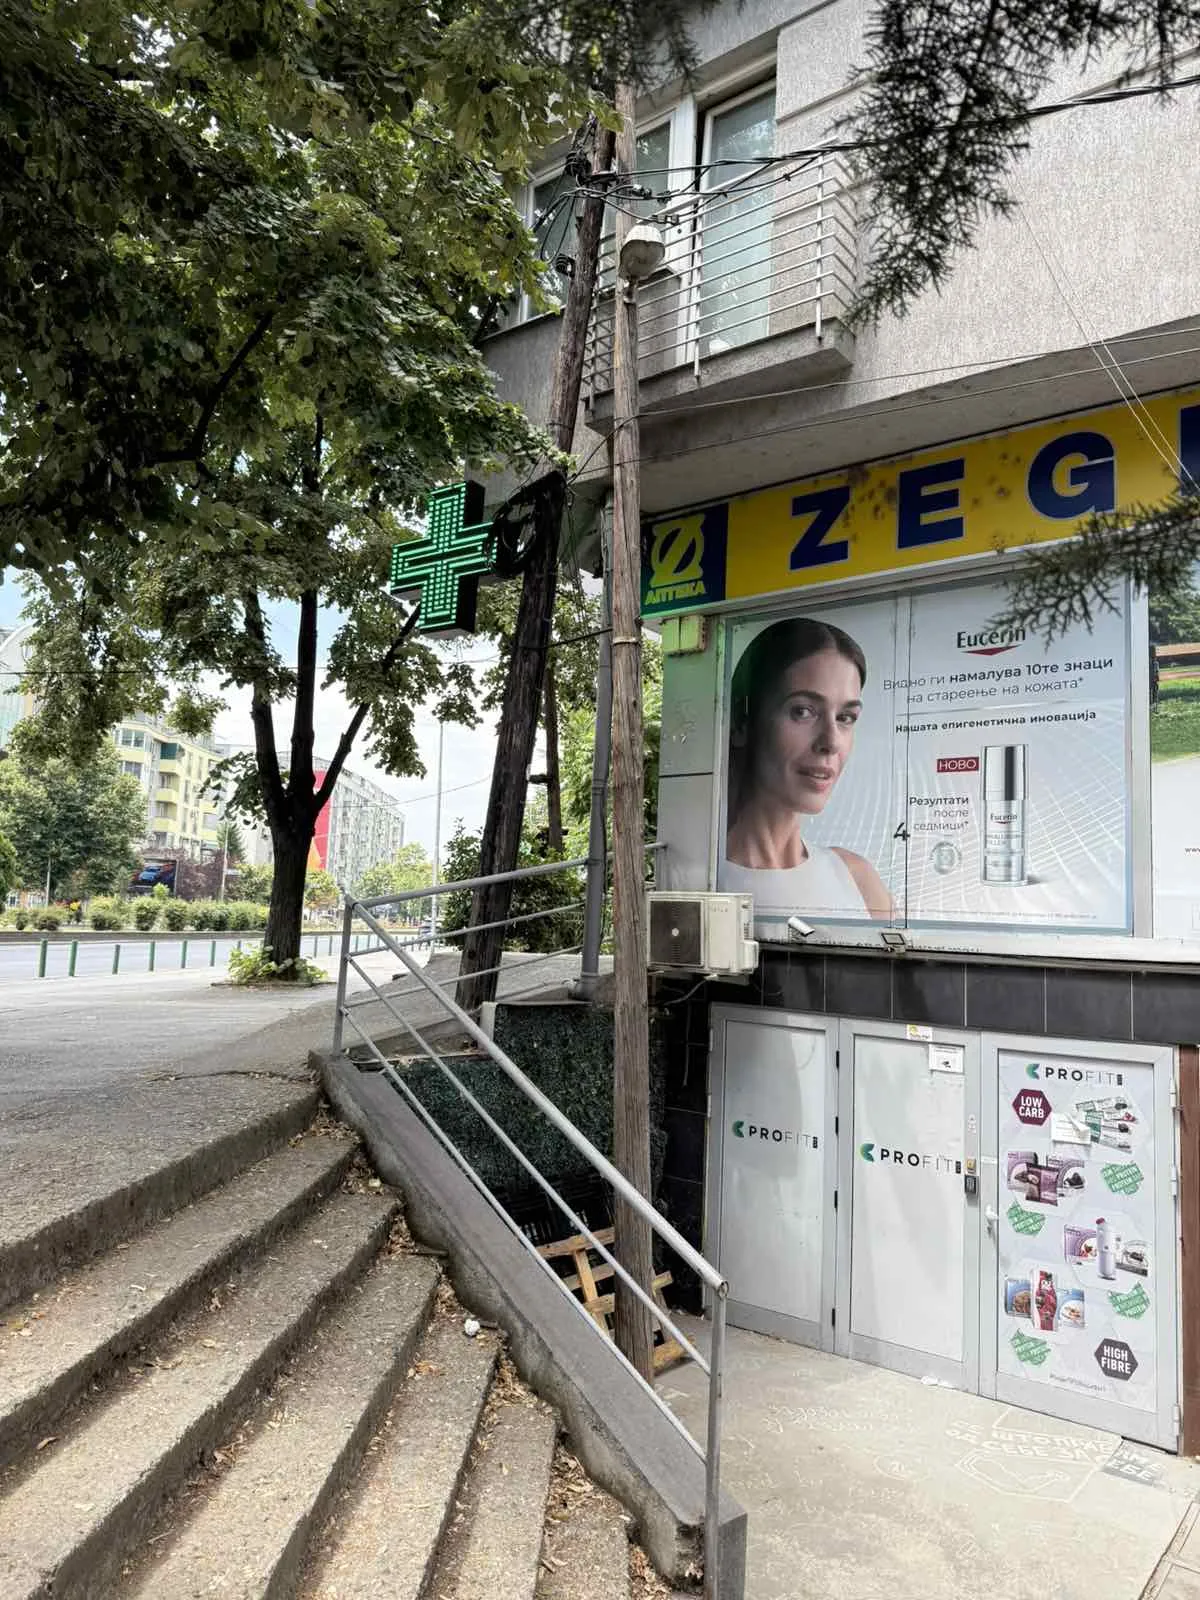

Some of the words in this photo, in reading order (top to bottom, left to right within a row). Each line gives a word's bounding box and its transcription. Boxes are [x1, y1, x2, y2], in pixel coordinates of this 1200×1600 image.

[644, 581, 707, 606] АПТЕКА
[956, 626, 1026, 649] Eucerin
[883, 677, 926, 691] Видно
[930, 675, 945, 685] ги
[949, 668, 1021, 684] намалува
[1026, 663, 1059, 676] 10те
[1064, 658, 1113, 673] знаци
[907, 694, 923, 705] на
[927, 687, 998, 704] стареење
[1002, 685, 1020, 696] на
[941, 715, 1026, 731] епигенетична
[1030, 709, 1097, 725] иновација
[938, 758, 977, 771] НОВО
[908, 796, 969, 808] Резултати
[934, 809, 969, 818] после
[893, 822, 911, 841] 4
[1045, 1067, 1115, 1086] PROFIT
[1020, 1095, 1043, 1107] LOW
[1019, 1105, 1045, 1118] CARB
[748, 1125, 811, 1146] PROFIT
[880, 1148, 953, 1173] PROFIT
[1103, 1346, 1129, 1362] HIGH
[1101, 1357, 1131, 1375] FIBRE
